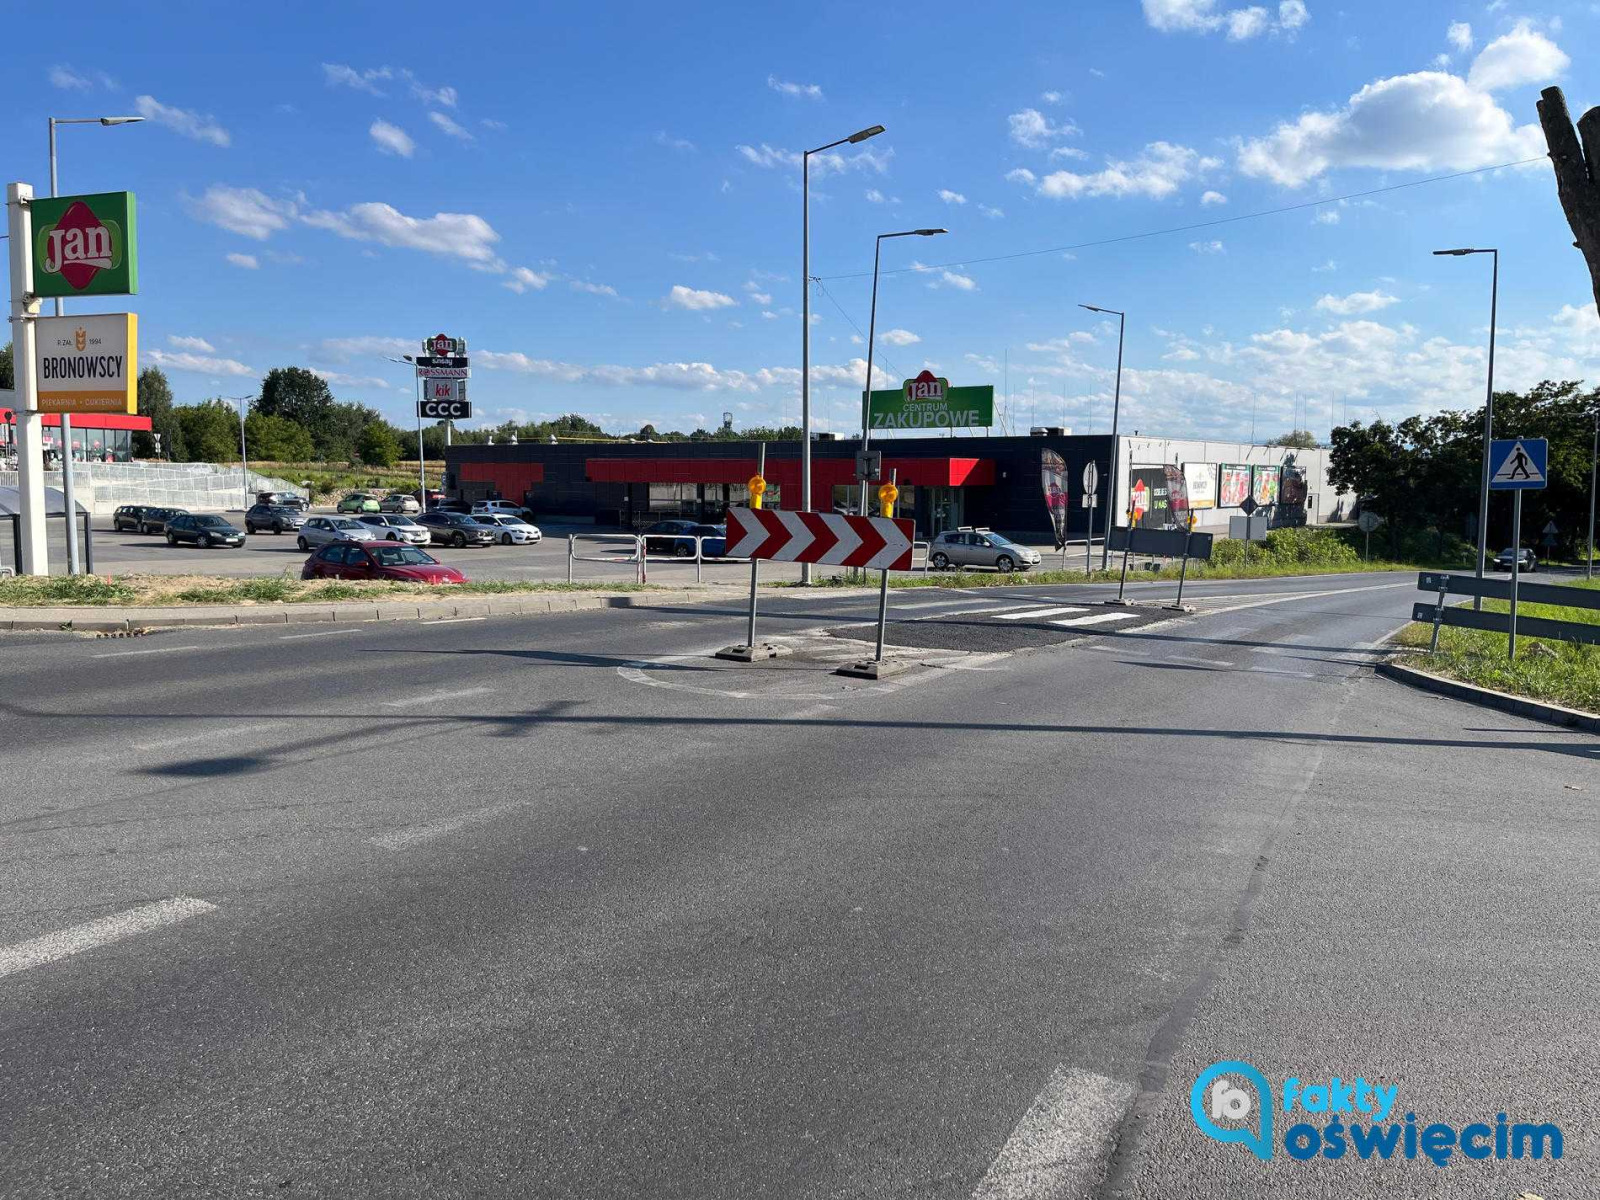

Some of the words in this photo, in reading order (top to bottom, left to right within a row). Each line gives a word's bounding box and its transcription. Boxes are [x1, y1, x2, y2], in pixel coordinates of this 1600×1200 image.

[45, 224, 112, 273] Jan
[89, 337, 102, 345] 1994
[430, 339, 453, 351] Jan
[43, 356, 122, 379] BRONOWSCY
[418, 368, 468, 377] ROSSMANN
[906, 381, 943, 402] Jan
[41, 398, 77, 406] PIEKARNIA
[85, 398, 122, 406] CUKIERNIA
[902, 402, 948, 412] CENTRUM
[425, 403, 461, 415] CCC
[873, 410, 980, 429] ZAKUPOWE
